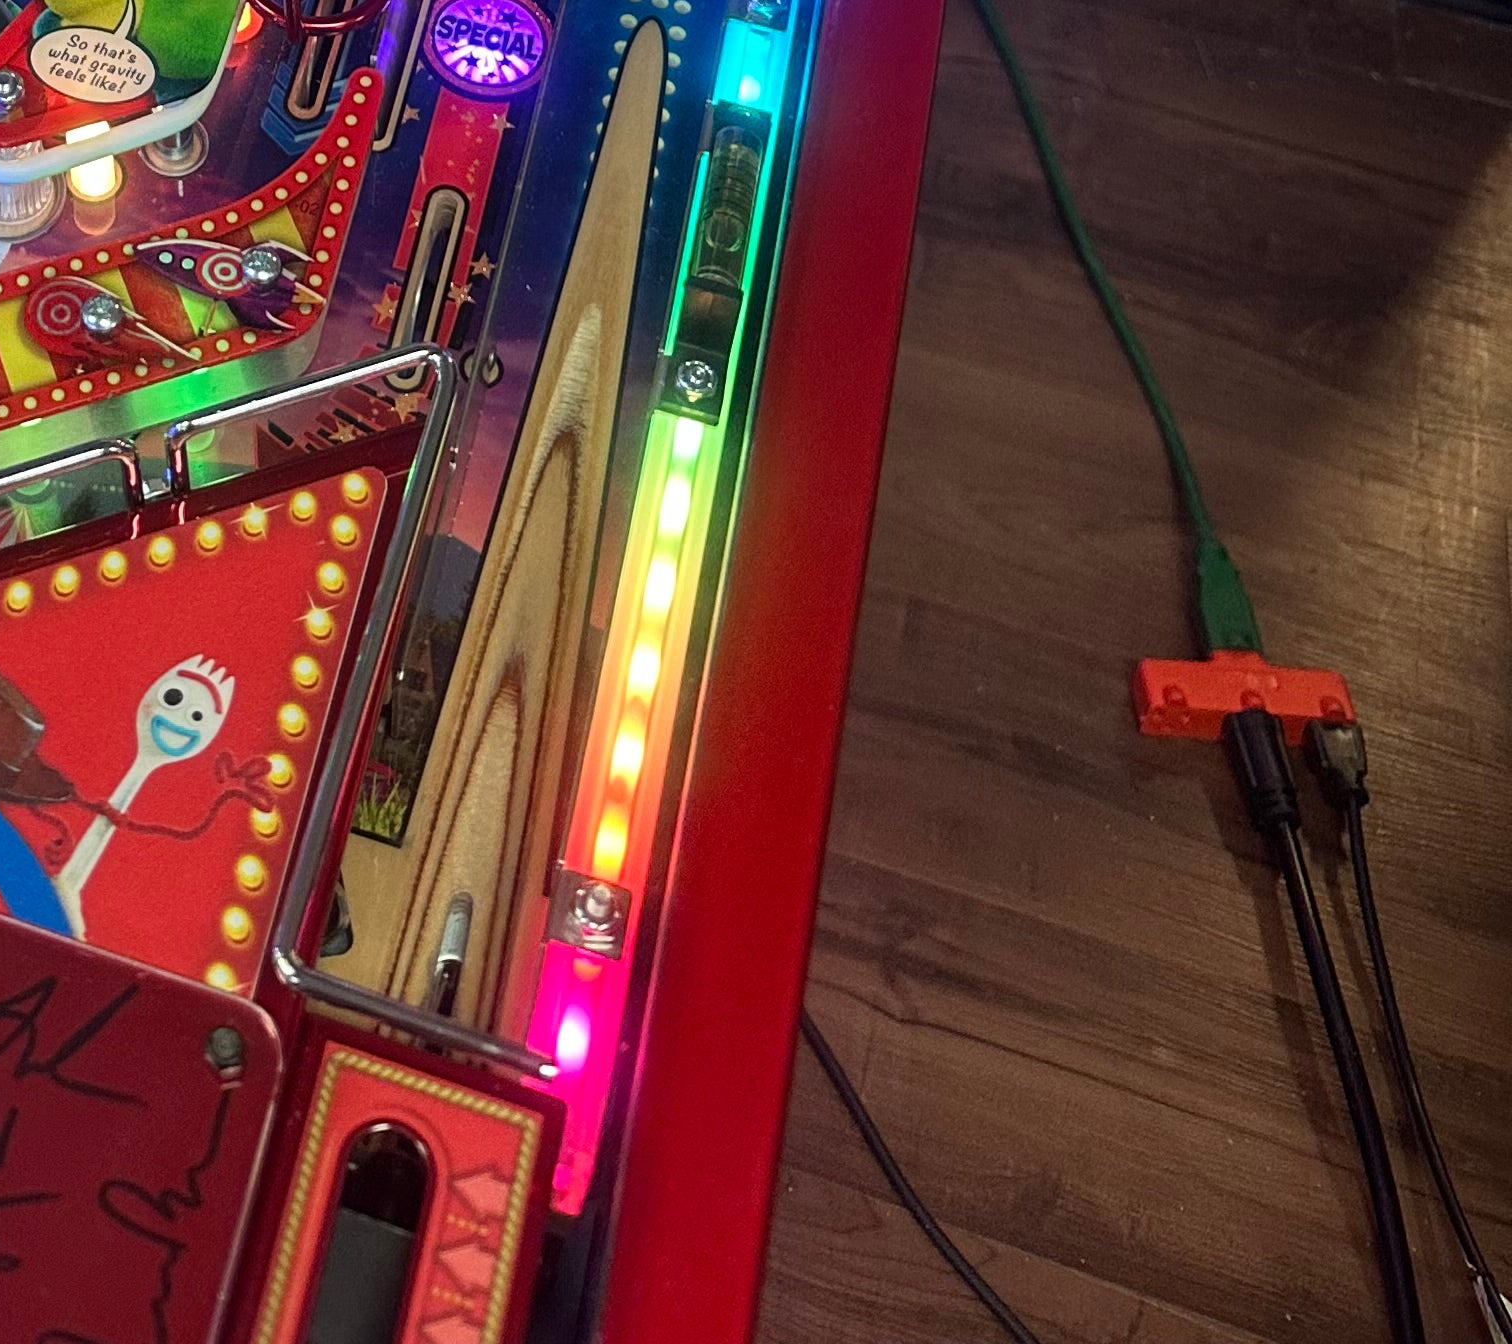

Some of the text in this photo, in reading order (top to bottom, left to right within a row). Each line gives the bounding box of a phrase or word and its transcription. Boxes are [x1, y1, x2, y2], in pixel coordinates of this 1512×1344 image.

[66, 33, 137, 64] So that's
[435, 14, 543, 63] SPECIAL
[47, 47, 147, 86] what gravity
[48, 62, 128, 94] feels like!
